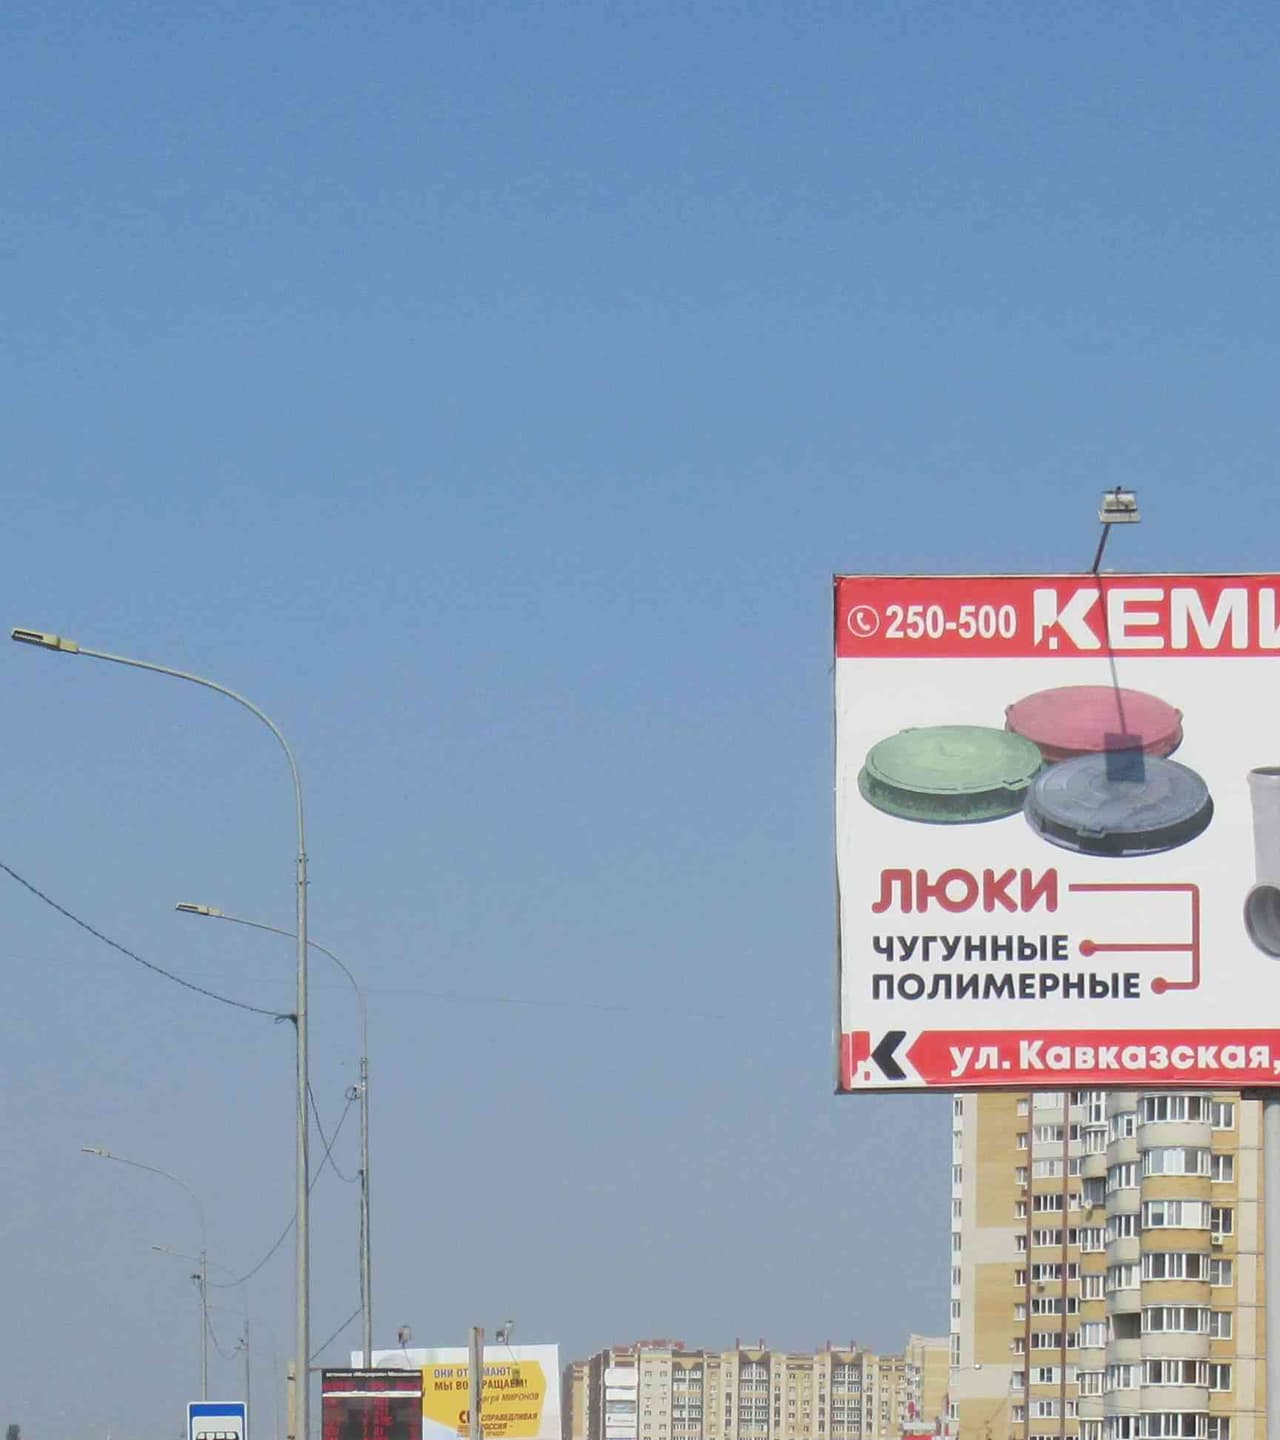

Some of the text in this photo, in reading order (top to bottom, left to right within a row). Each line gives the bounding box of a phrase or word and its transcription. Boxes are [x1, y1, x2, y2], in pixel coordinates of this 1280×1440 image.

[885, 604, 1017, 639] 250-500
[871, 868, 1058, 914] ЛЮКИ
[872, 935, 1069, 962] ЧУГУННЫЕ
[872, 973, 1141, 1000] ПОЛИМЕРНЫЕ
[950, 1044, 1010, 1077] ул.
[434, 1367, 511, 1378] ОНИ ОТМАЮТ
[434, 1379, 528, 1391] МЫ ВОРАЩАЕМ!
